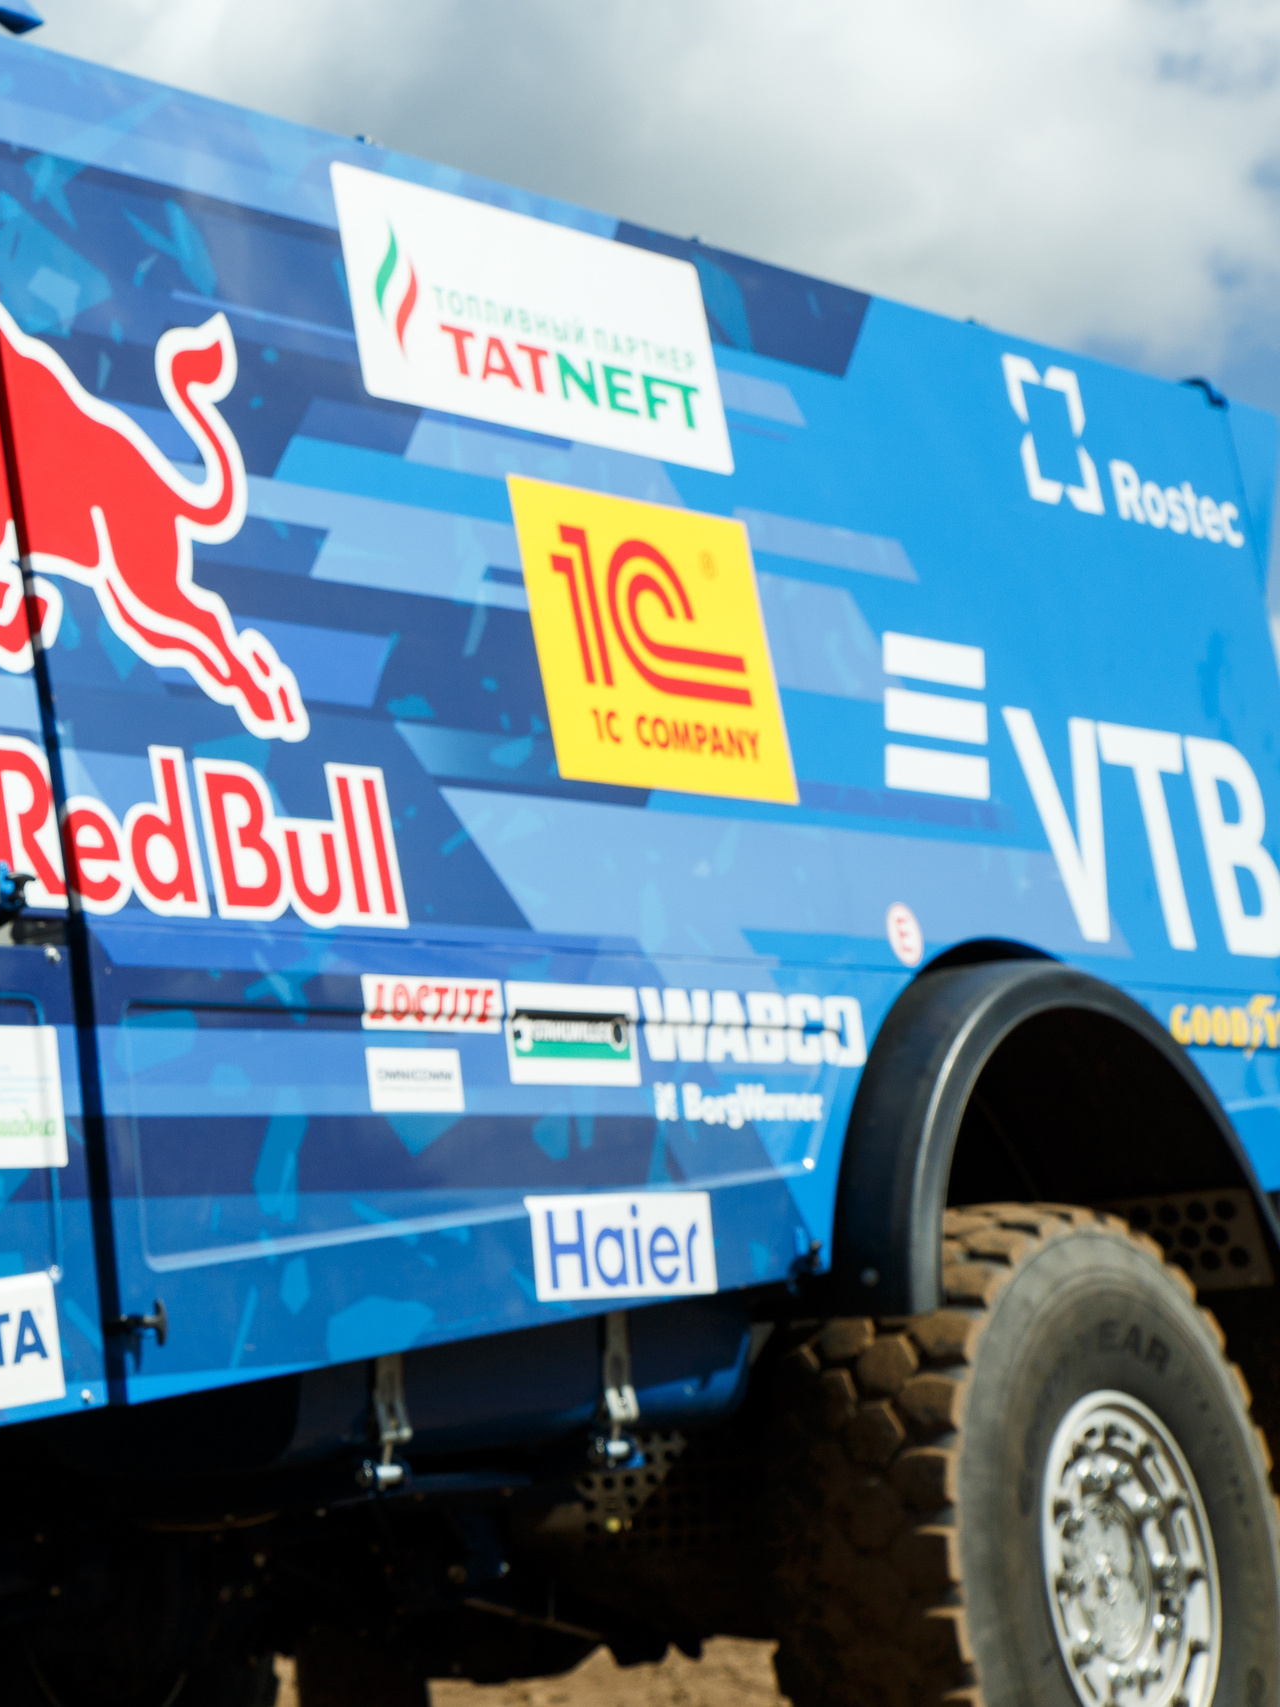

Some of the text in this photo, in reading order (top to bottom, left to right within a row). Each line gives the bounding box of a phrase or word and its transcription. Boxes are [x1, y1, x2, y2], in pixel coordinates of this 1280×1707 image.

[432, 285, 695, 373] ТОПЛИВНЫЙ ПАРТНЕР
[440, 324, 700, 430] TATNEFT
[1108, 458, 1245, 548] Rostec
[636, 714, 760, 764] COMPANY
[1002, 705, 1280, 958] VTB
[370, 984, 494, 1023] LOCTITE
[639, 986, 867, 1067] WABCO
[682, 1083, 823, 1129] BorgWarner
[546, 1204, 697, 1290] Haier
